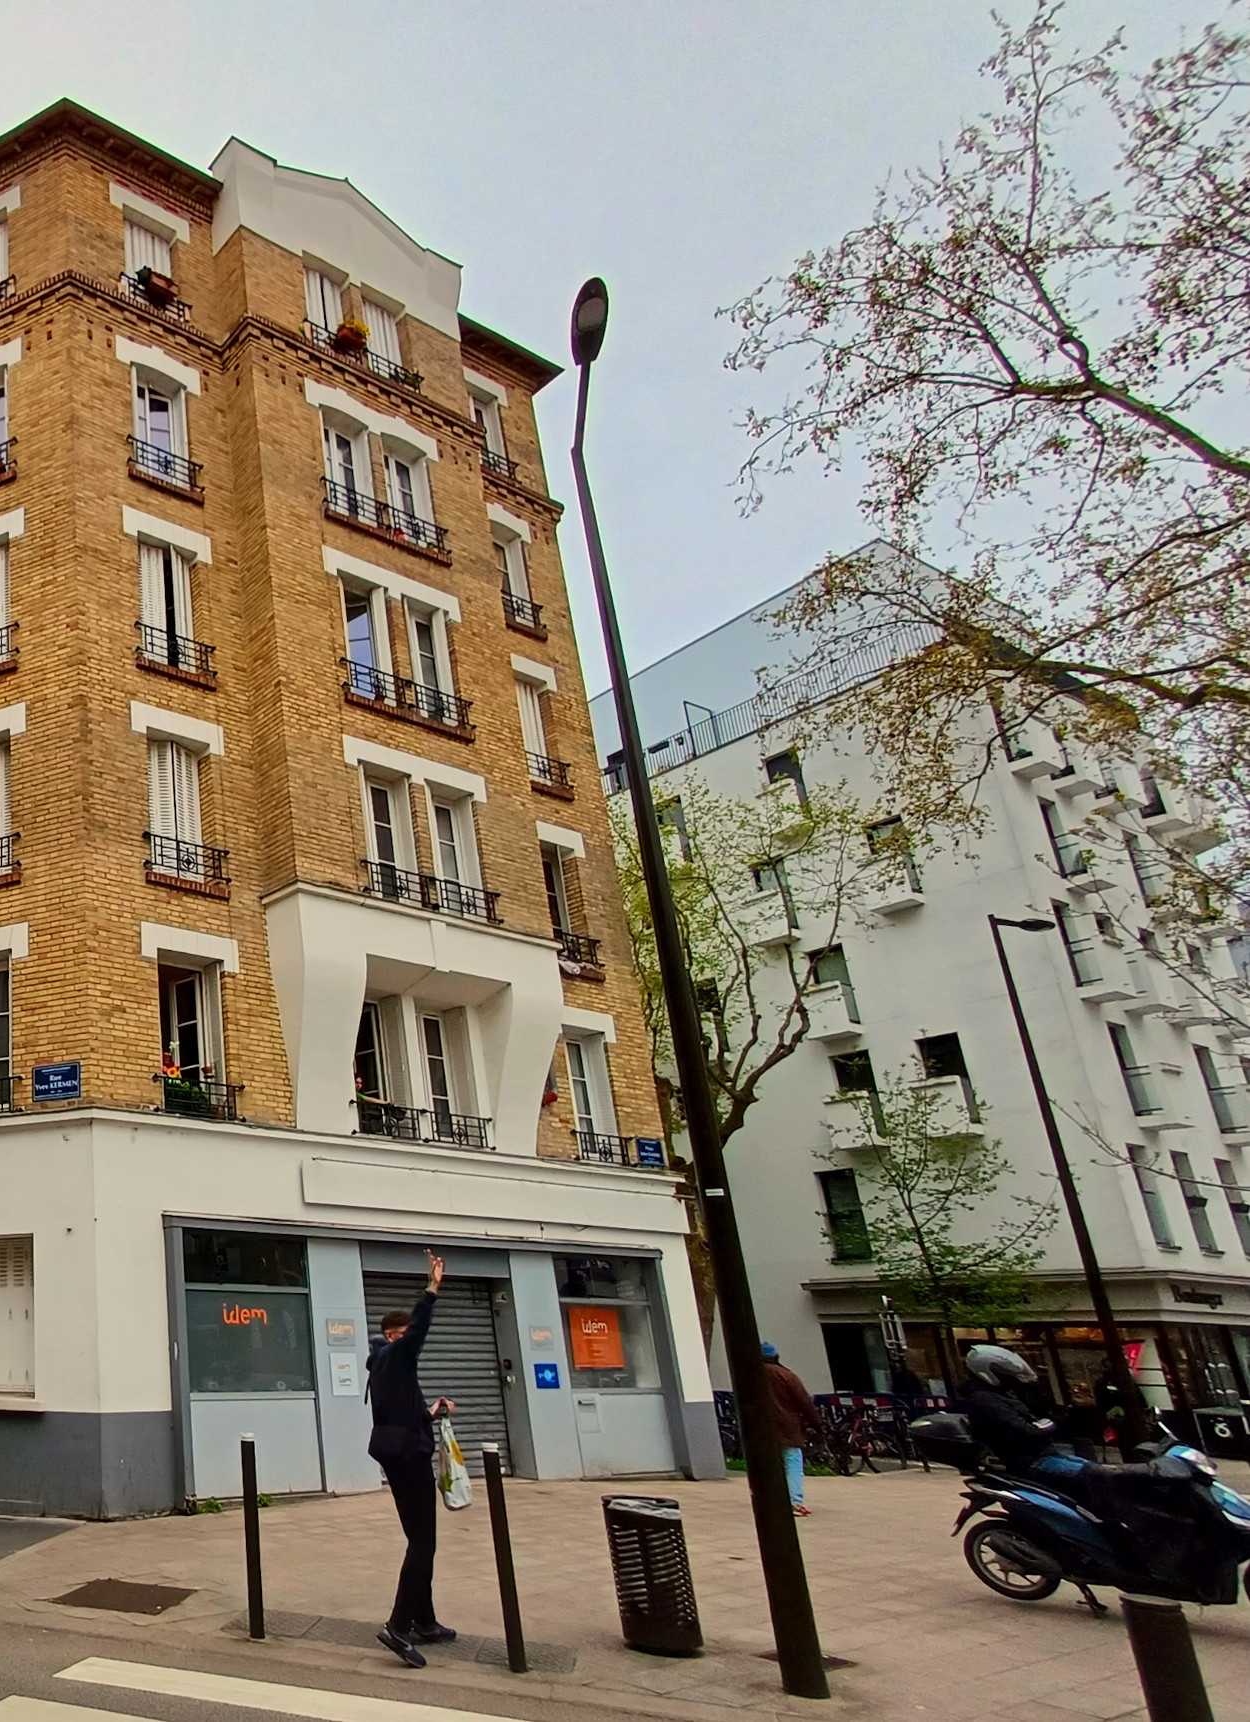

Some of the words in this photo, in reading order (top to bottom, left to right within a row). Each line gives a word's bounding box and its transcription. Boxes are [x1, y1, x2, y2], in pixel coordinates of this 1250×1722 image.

[35, 1083, 49, 1091] Yves
[49, 1079, 78, 1090] KERMEN
[49, 1074, 62, 1082] Rue
[222, 1302, 268, 1325] idem
[581, 1318, 608, 1334] idem
